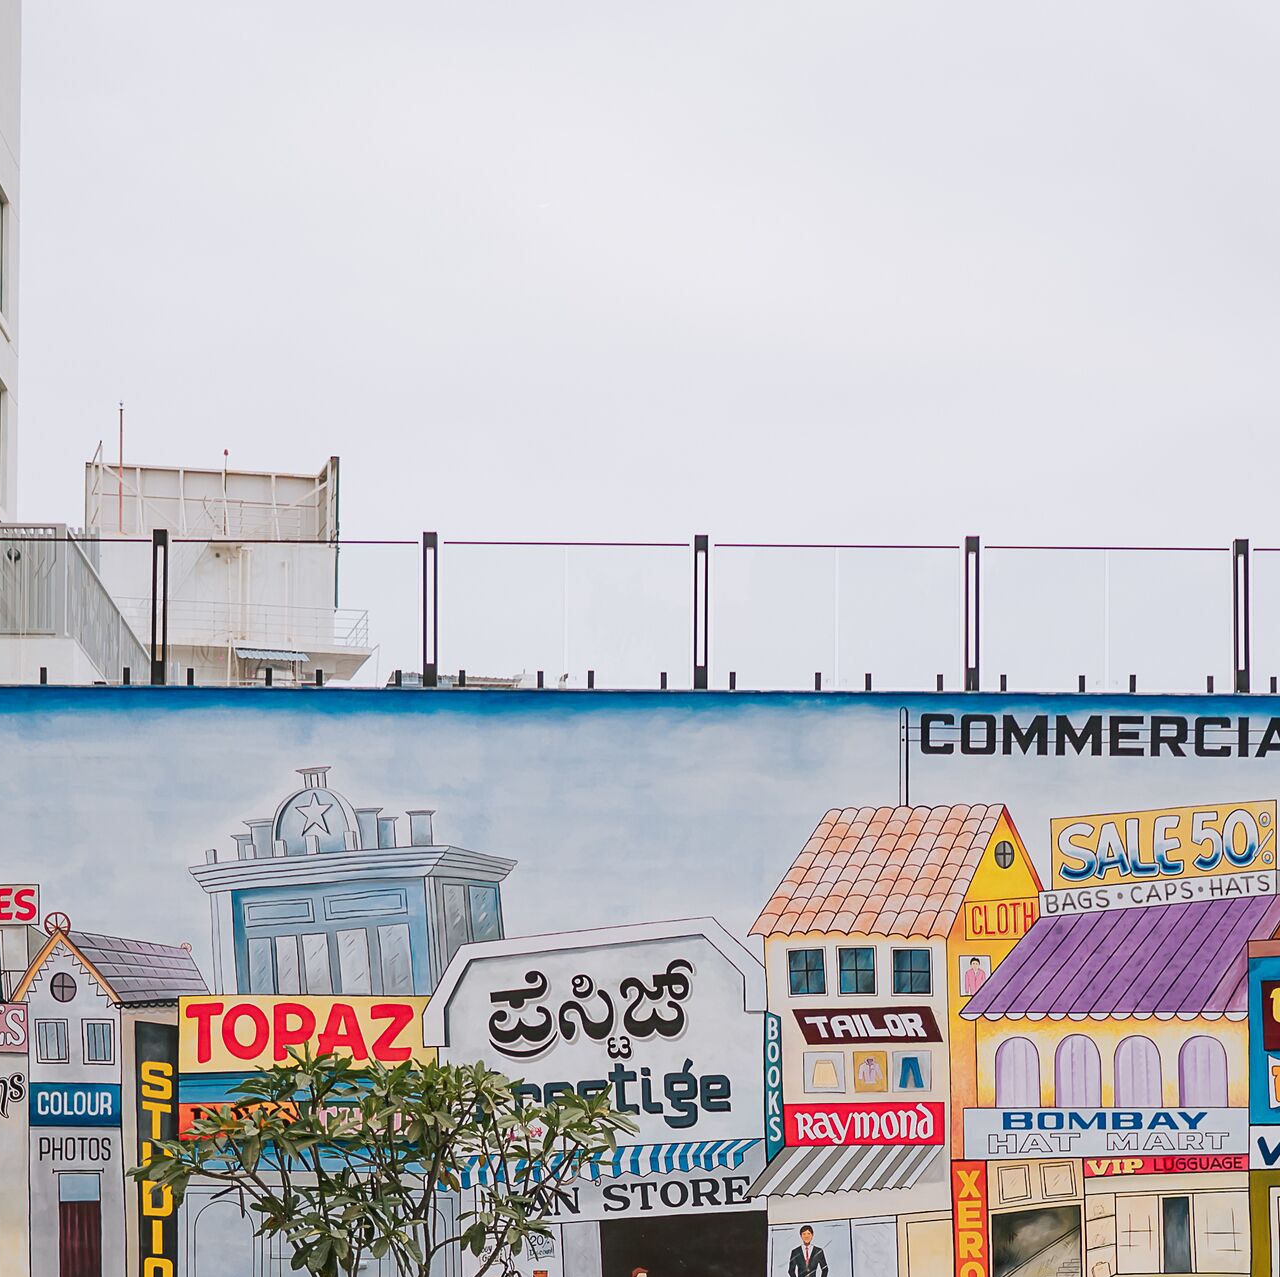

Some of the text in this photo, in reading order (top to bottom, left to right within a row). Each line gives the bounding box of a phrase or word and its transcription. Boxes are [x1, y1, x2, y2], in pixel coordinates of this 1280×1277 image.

[1058, 809, 1274, 882] SALE 50%
[1044, 875, 1270, 914] BAGS CAPS HATS
[972, 902, 1035, 935] CLOTH
[186, 1002, 414, 1064] TOPAZ
[804, 1013, 928, 1039] TAILOR
[473, 1057, 732, 1129] restige
[767, 1017, 782, 1142] BOOKS
[37, 1091, 113, 1116] COLOUR
[1002, 1111, 1208, 1131] BOMBAY
[793, 1103, 934, 1145] Raymond
[39, 1137, 112, 1162] PHOTOS
[988, 1132, 1230, 1154] HAT MART
[1086, 1156, 1243, 1176] VIP LUGGUAGE
[602, 1176, 752, 1213] STORE
